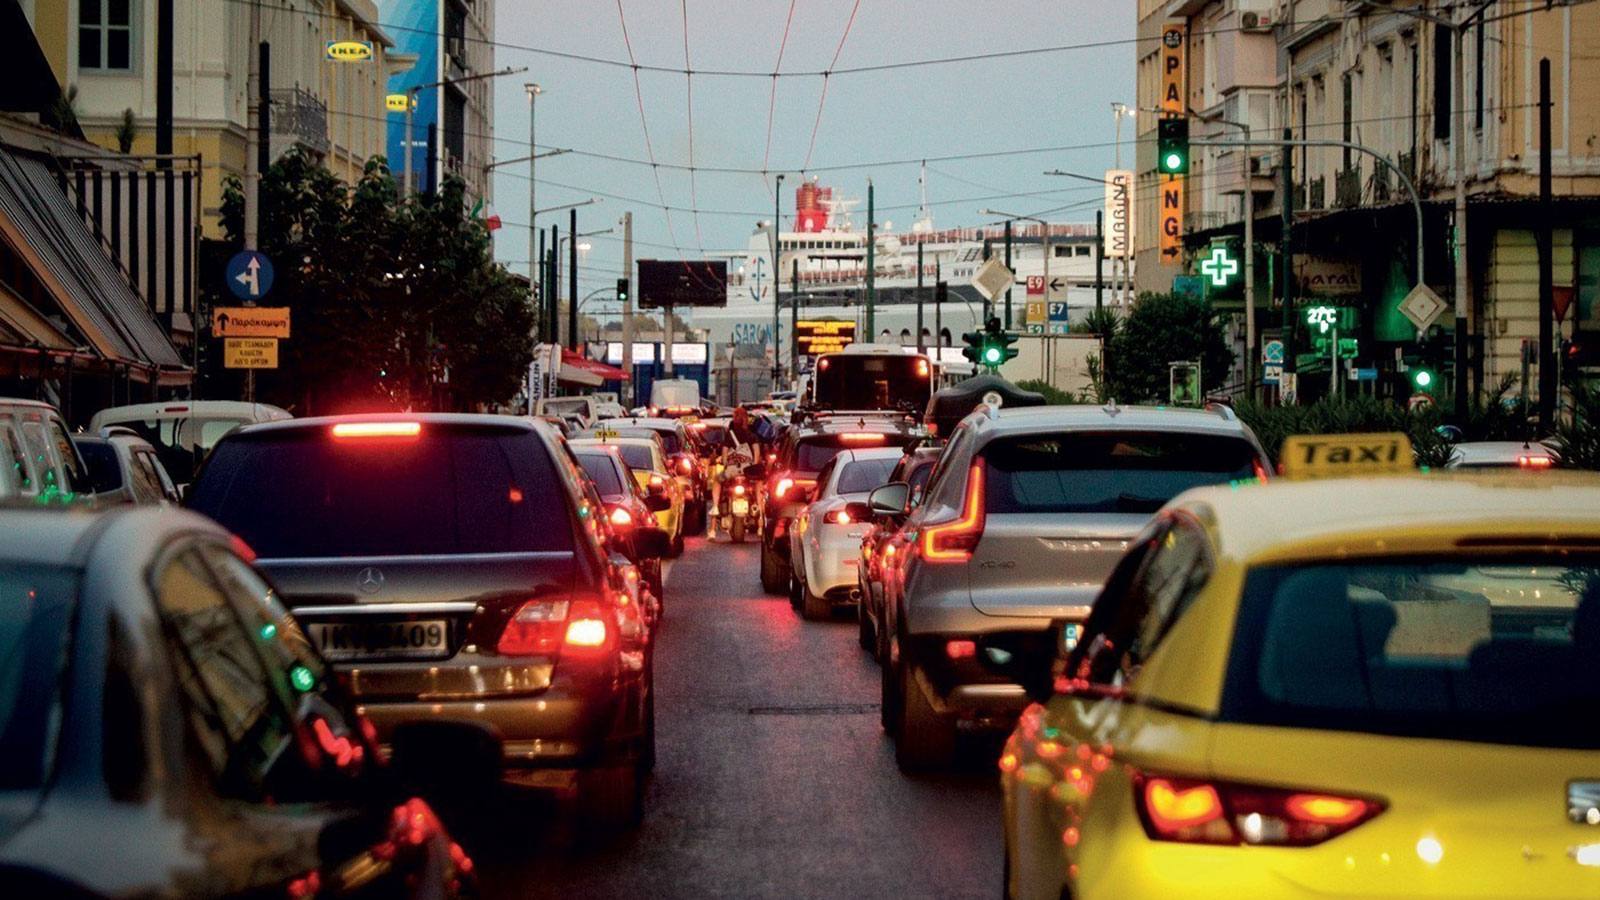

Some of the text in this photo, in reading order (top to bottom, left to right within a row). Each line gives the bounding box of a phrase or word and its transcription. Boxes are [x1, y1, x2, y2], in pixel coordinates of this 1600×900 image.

[1165, 56, 1180, 236] PANG
[1112, 175, 1125, 250] MARINA
[1028, 276, 1043, 289] E9
[1028, 303, 1041, 315] E1
[1049, 302, 1064, 315] E7
[1297, 441, 1398, 463] Taxi
